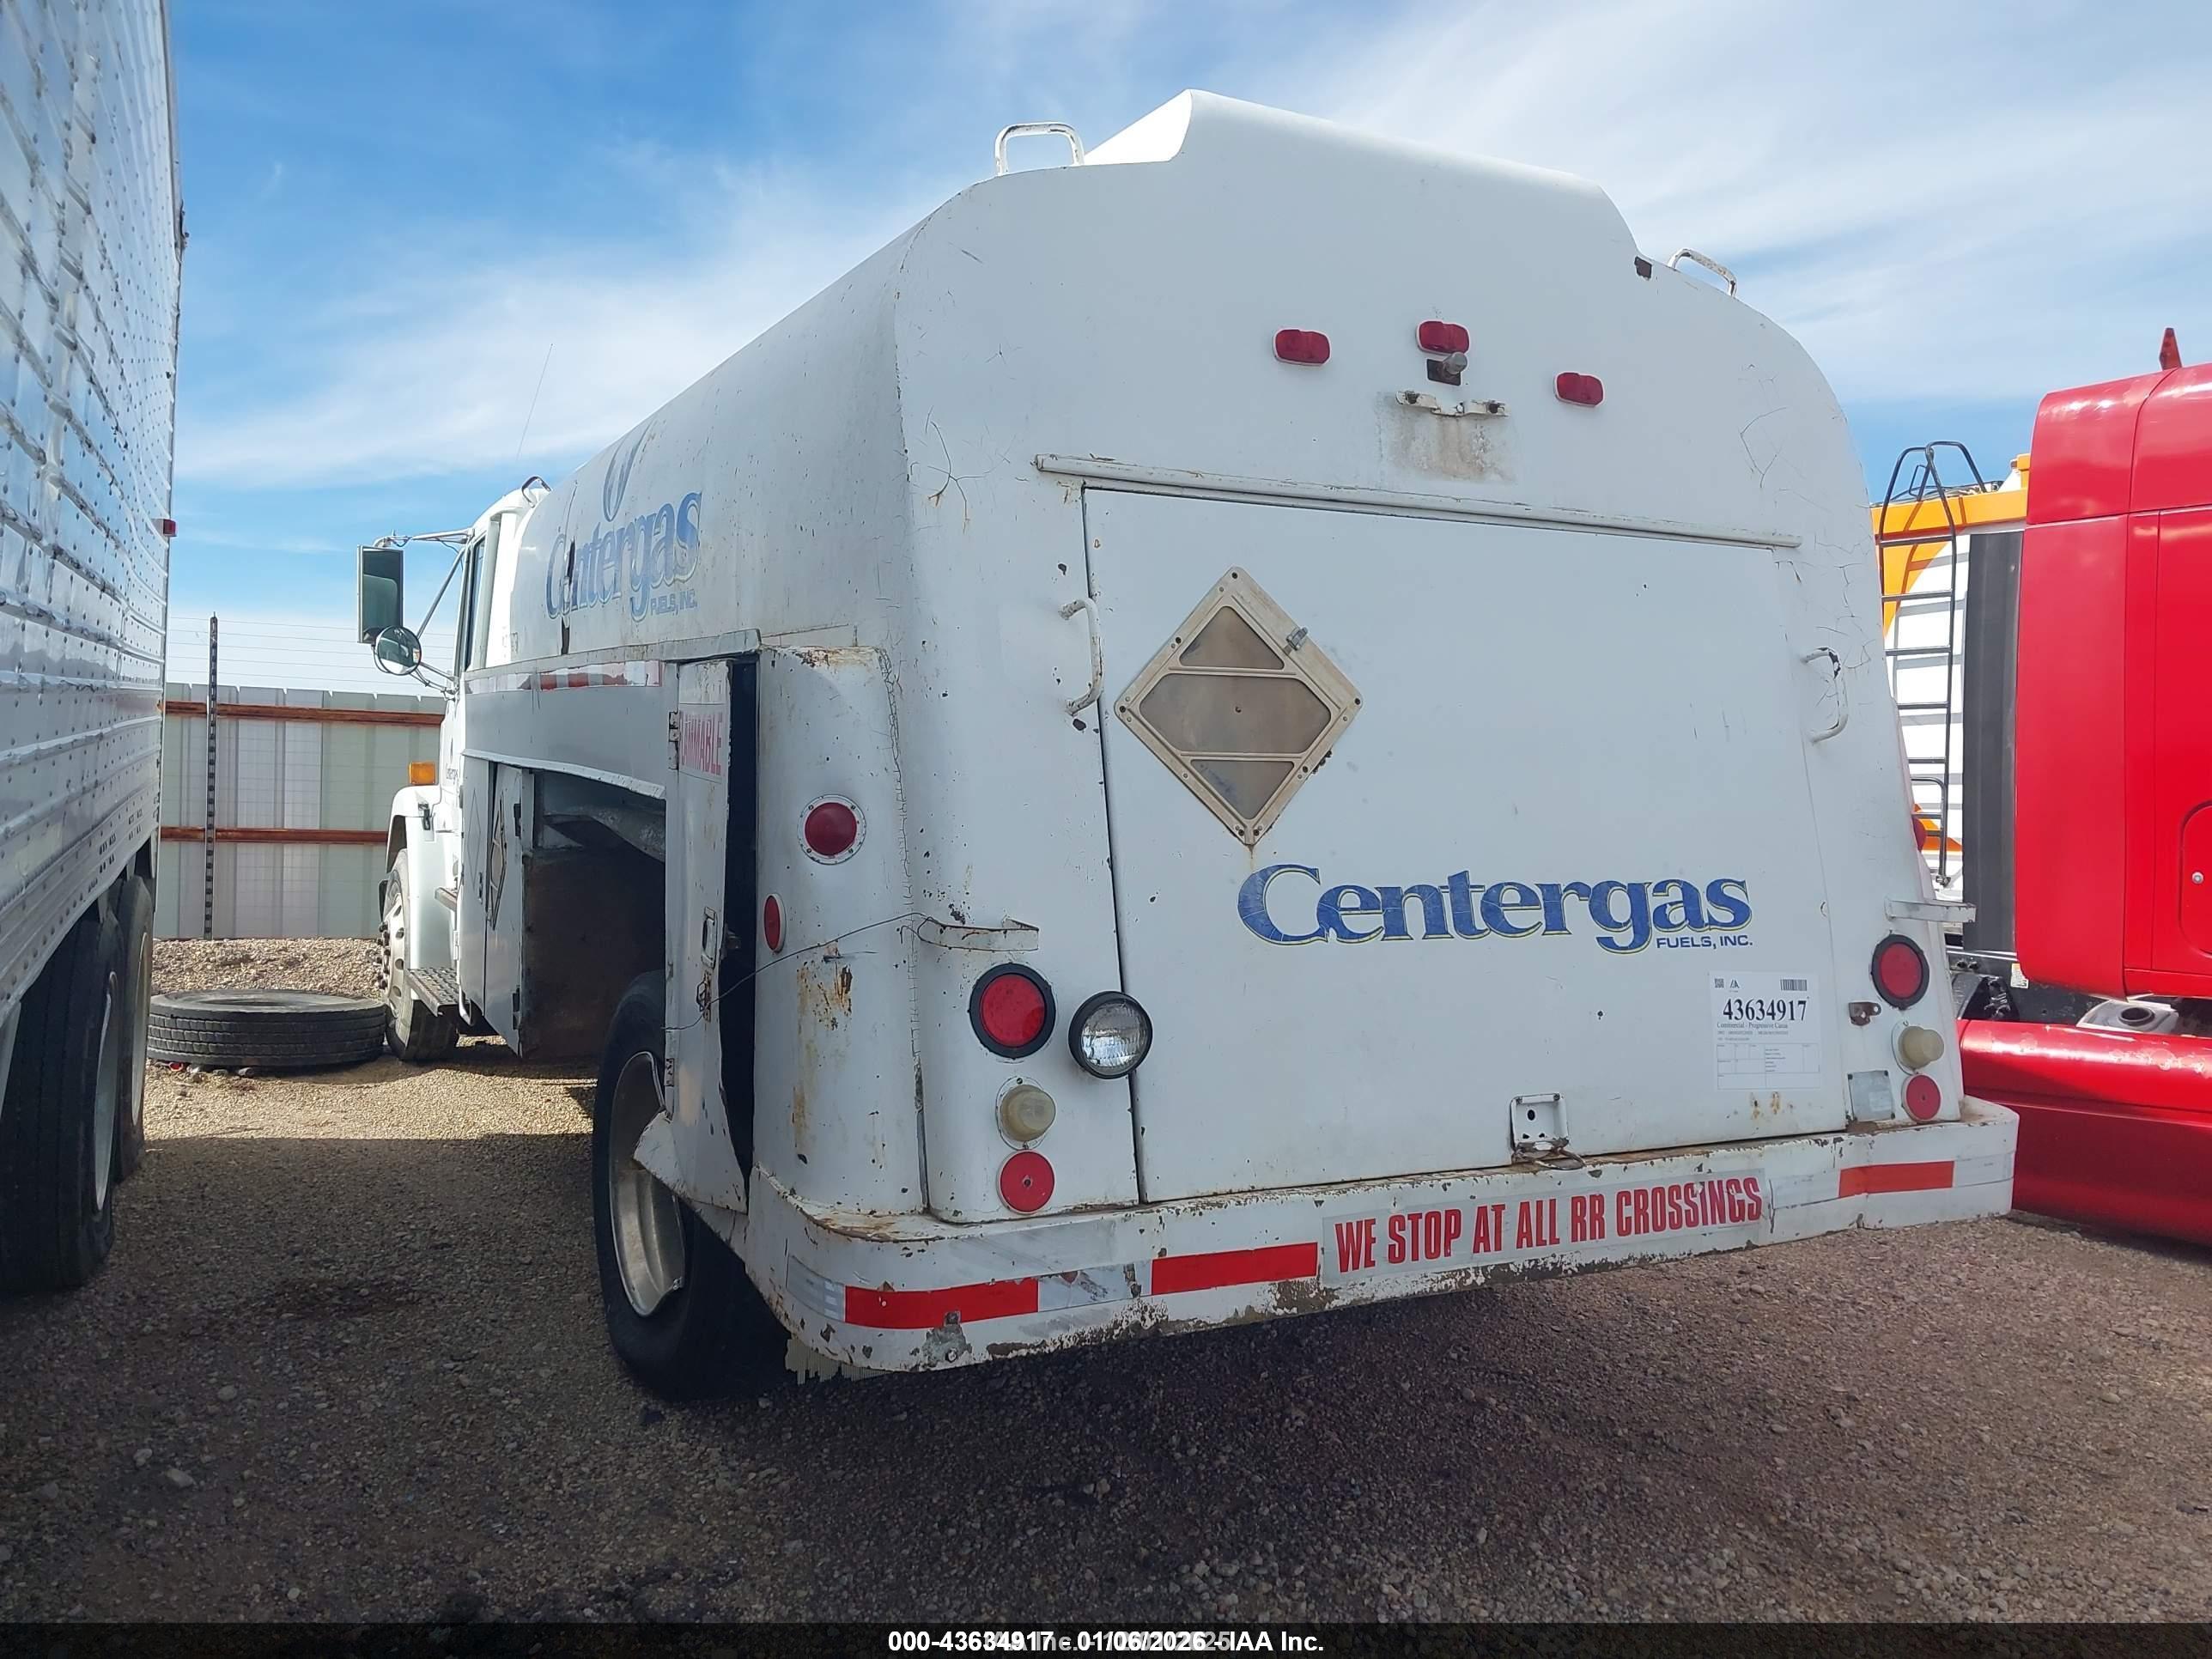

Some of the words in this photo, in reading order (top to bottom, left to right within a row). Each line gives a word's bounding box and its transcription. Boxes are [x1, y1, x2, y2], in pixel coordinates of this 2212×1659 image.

[546, 491, 702, 623] Cntergas
[1237, 864, 1753, 954] Centergas
[1656, 936, 1717, 949] FUELS,
[1720, 935, 1753, 946] INC.
[1723, 998, 1807, 1021] 43634917
[1334, 1218, 1376, 1273] WE
[1388, 1208, 1462, 1265] STOP
[1472, 1202, 1505, 1255] AT
[1516, 1198, 1560, 1249] ALL
[1571, 1193, 1605, 1243] RR
[1615, 1176, 1763, 1237] CROSSINGS
